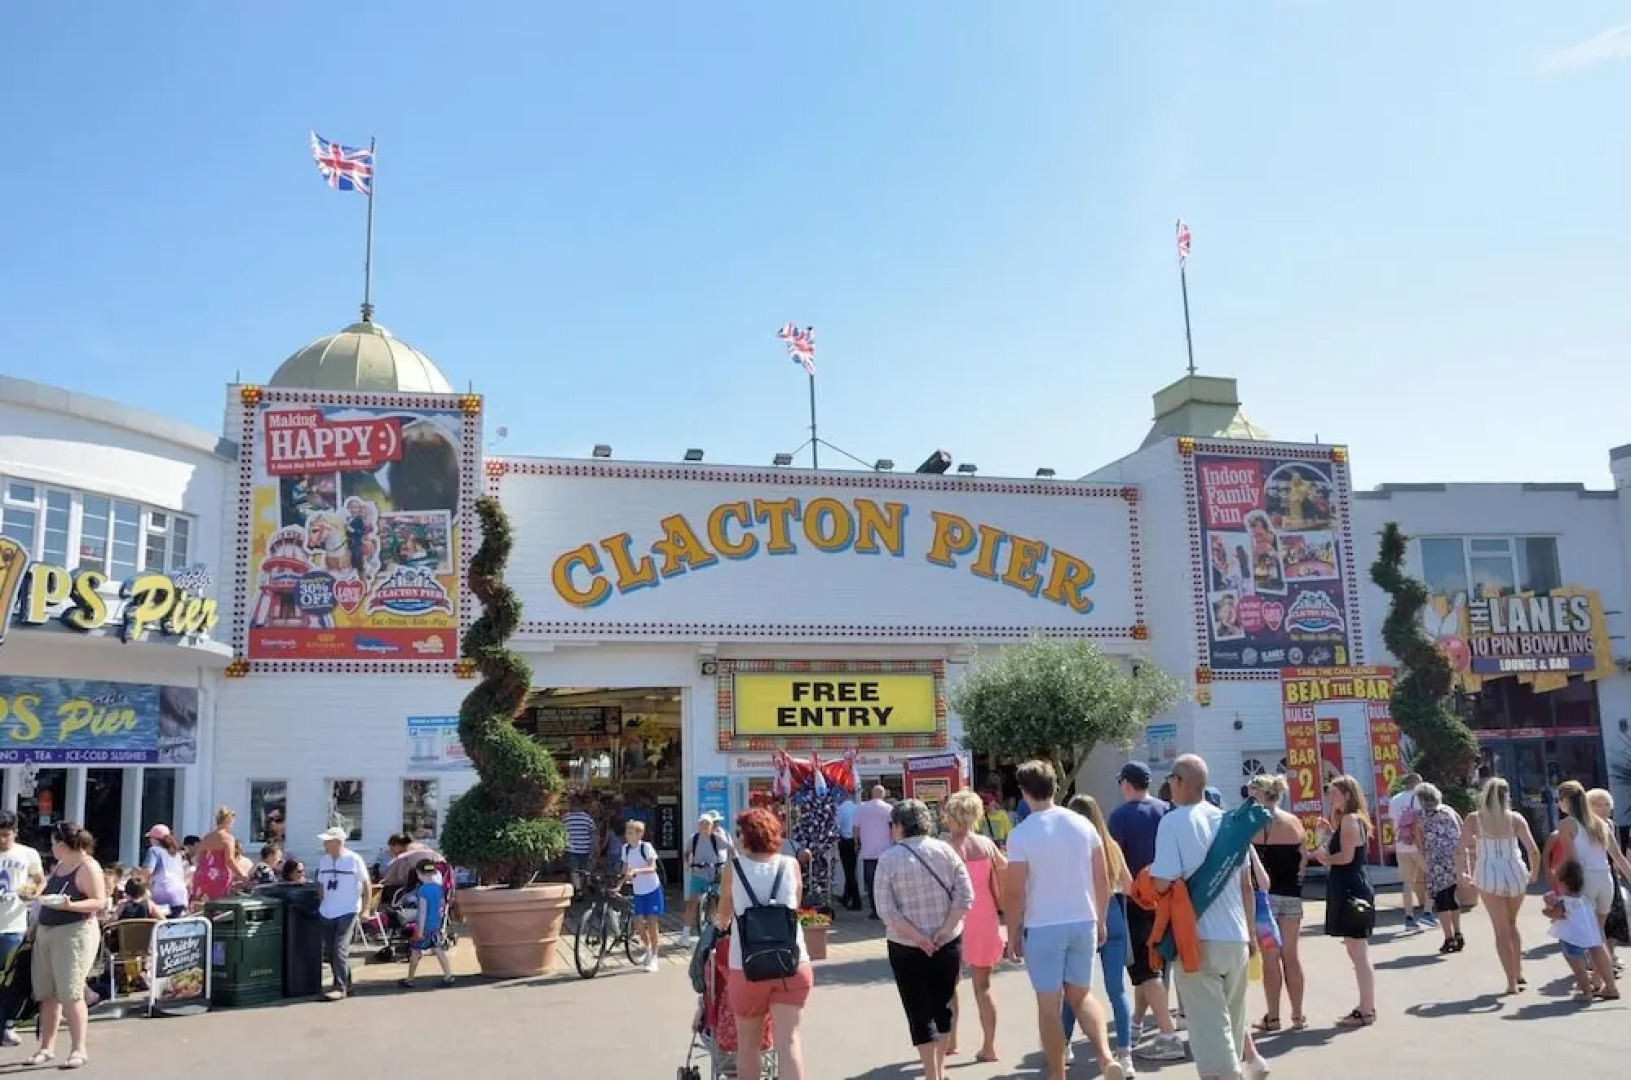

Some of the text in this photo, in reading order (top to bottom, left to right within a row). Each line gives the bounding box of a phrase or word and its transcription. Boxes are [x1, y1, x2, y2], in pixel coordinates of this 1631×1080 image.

[269, 413, 317, 429] Making
[270, 425, 374, 461] HAPPY
[1202, 466, 1255, 486] Indoor
[1206, 485, 1260, 508] Family
[1209, 505, 1241, 525] Fun
[550, 497, 1097, 617] CLACTON PIER
[131, 575, 218, 640] Pier
[300, 593, 331, 605] OFF
[1470, 597, 1590, 633] THE LANES
[1471, 635, 1593, 656] 10 PIN BOWLING
[1500, 660, 1537, 670] LOUNGE
[791, 682, 880, 703] FREE
[1286, 678, 1390, 704] BEAT THE BAR
[59, 701, 137, 742] Pier
[777, 707, 894, 727] ENTRY
[35, 751, 52, 761] TEA
[1289, 748, 1316, 765] BAR
[1375, 744, 1399, 761] BAR
[1299, 768, 1314, 799] 2
